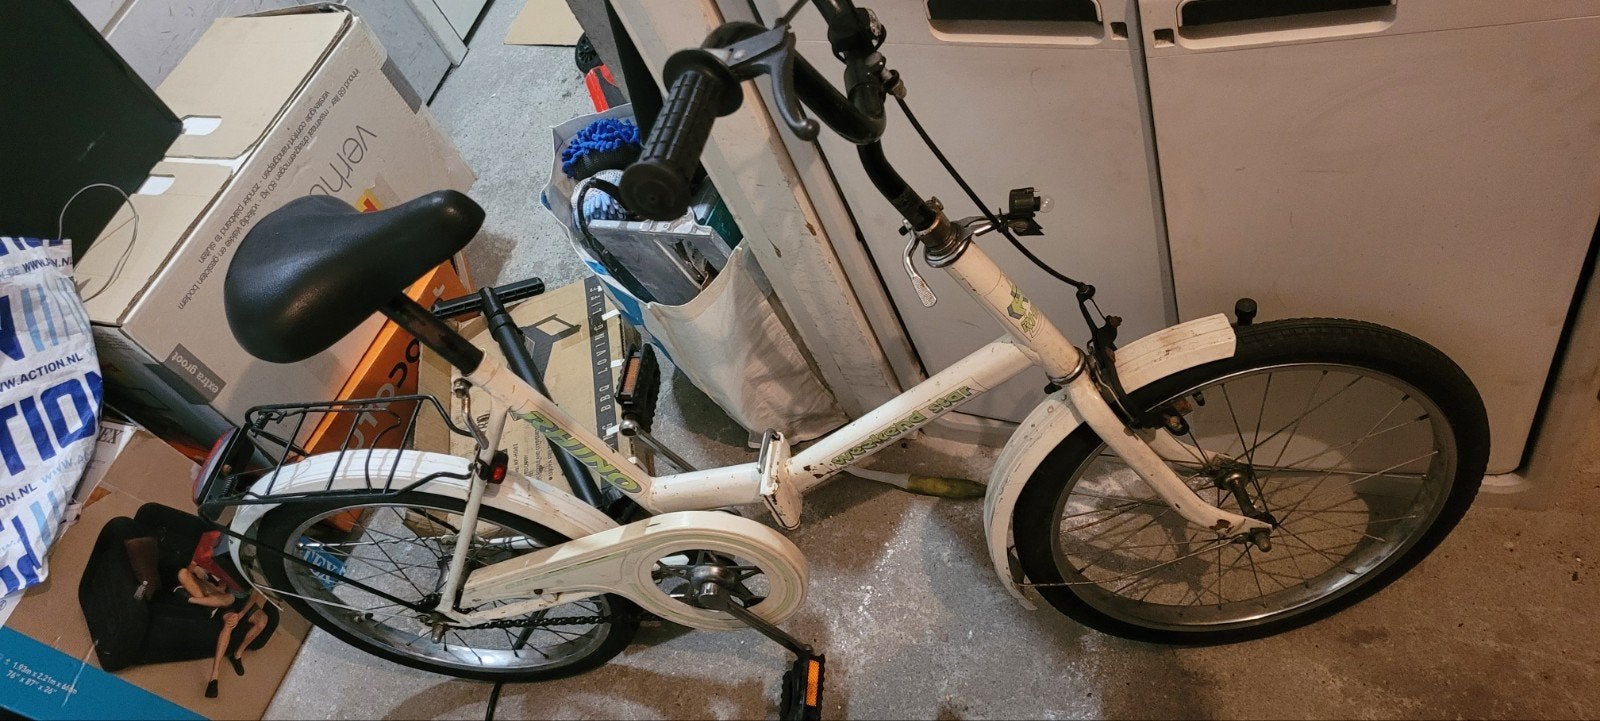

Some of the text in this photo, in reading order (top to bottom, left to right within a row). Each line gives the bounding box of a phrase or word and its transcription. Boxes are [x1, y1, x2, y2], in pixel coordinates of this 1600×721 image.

[336, 86, 346, 96] 68
[343, 68, 359, 88] inhoud
[267, 180, 277, 190] 80
[592, 323, 608, 374] LOVING
[171, 351, 219, 393] extra groot
[598, 384, 611, 411] BBQ
[831, 385, 972, 466] weekend star
[519, 411, 643, 493] RHINO
